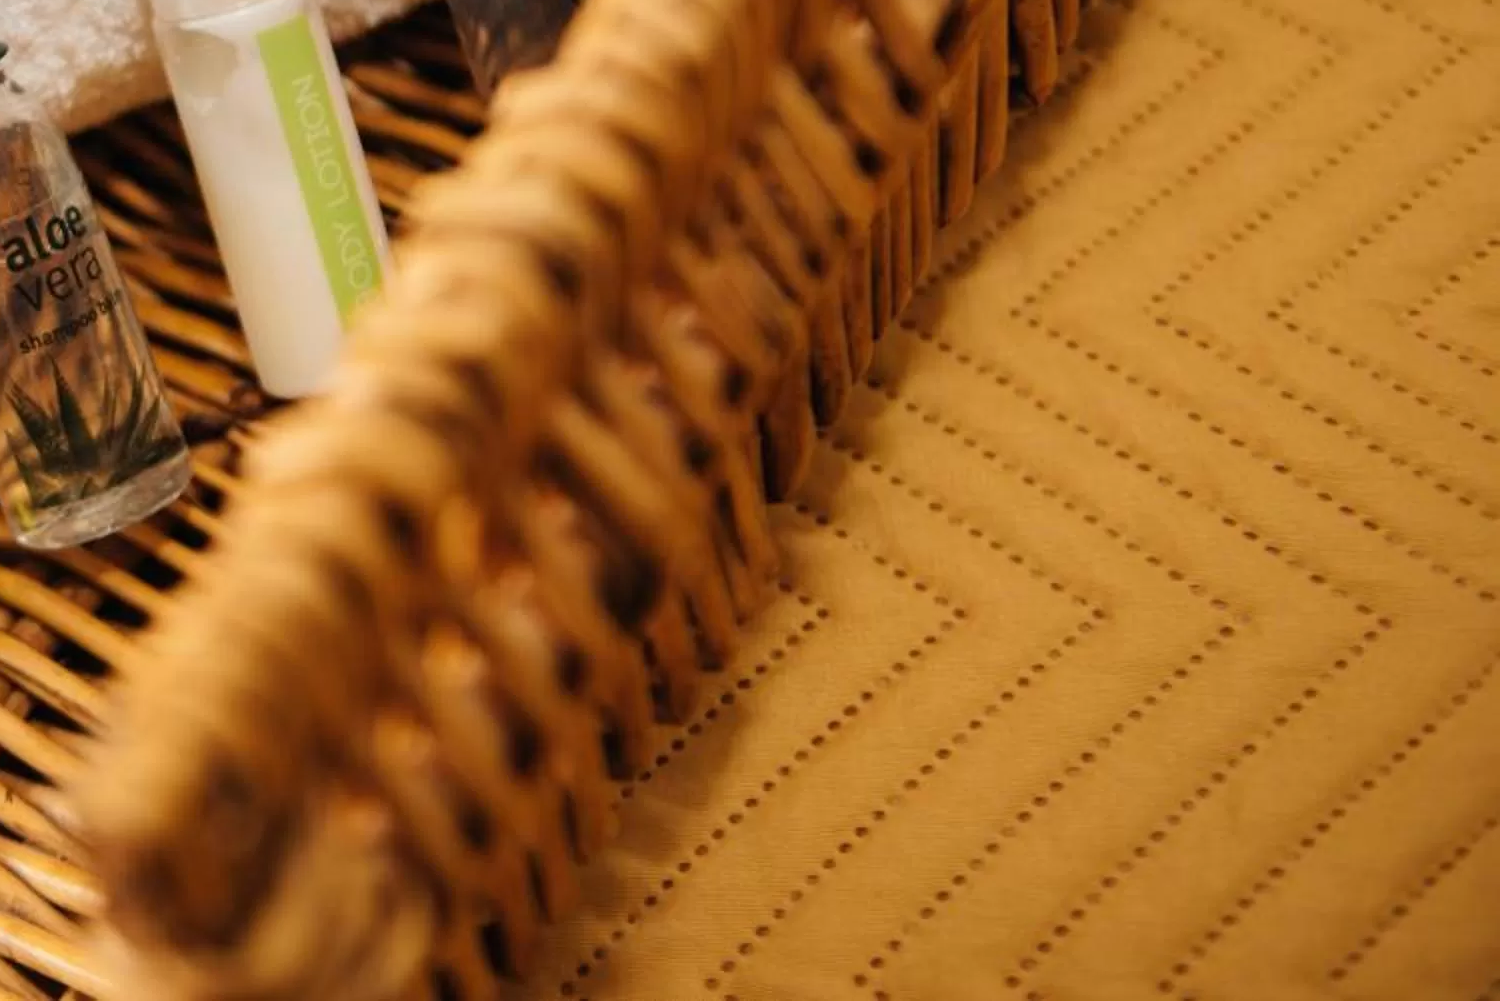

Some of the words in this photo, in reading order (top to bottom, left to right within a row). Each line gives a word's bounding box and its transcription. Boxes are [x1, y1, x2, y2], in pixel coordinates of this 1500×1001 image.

[291, 74, 350, 208] LOTION
[1, 204, 87, 273] aloe
[13, 246, 103, 312] vera
